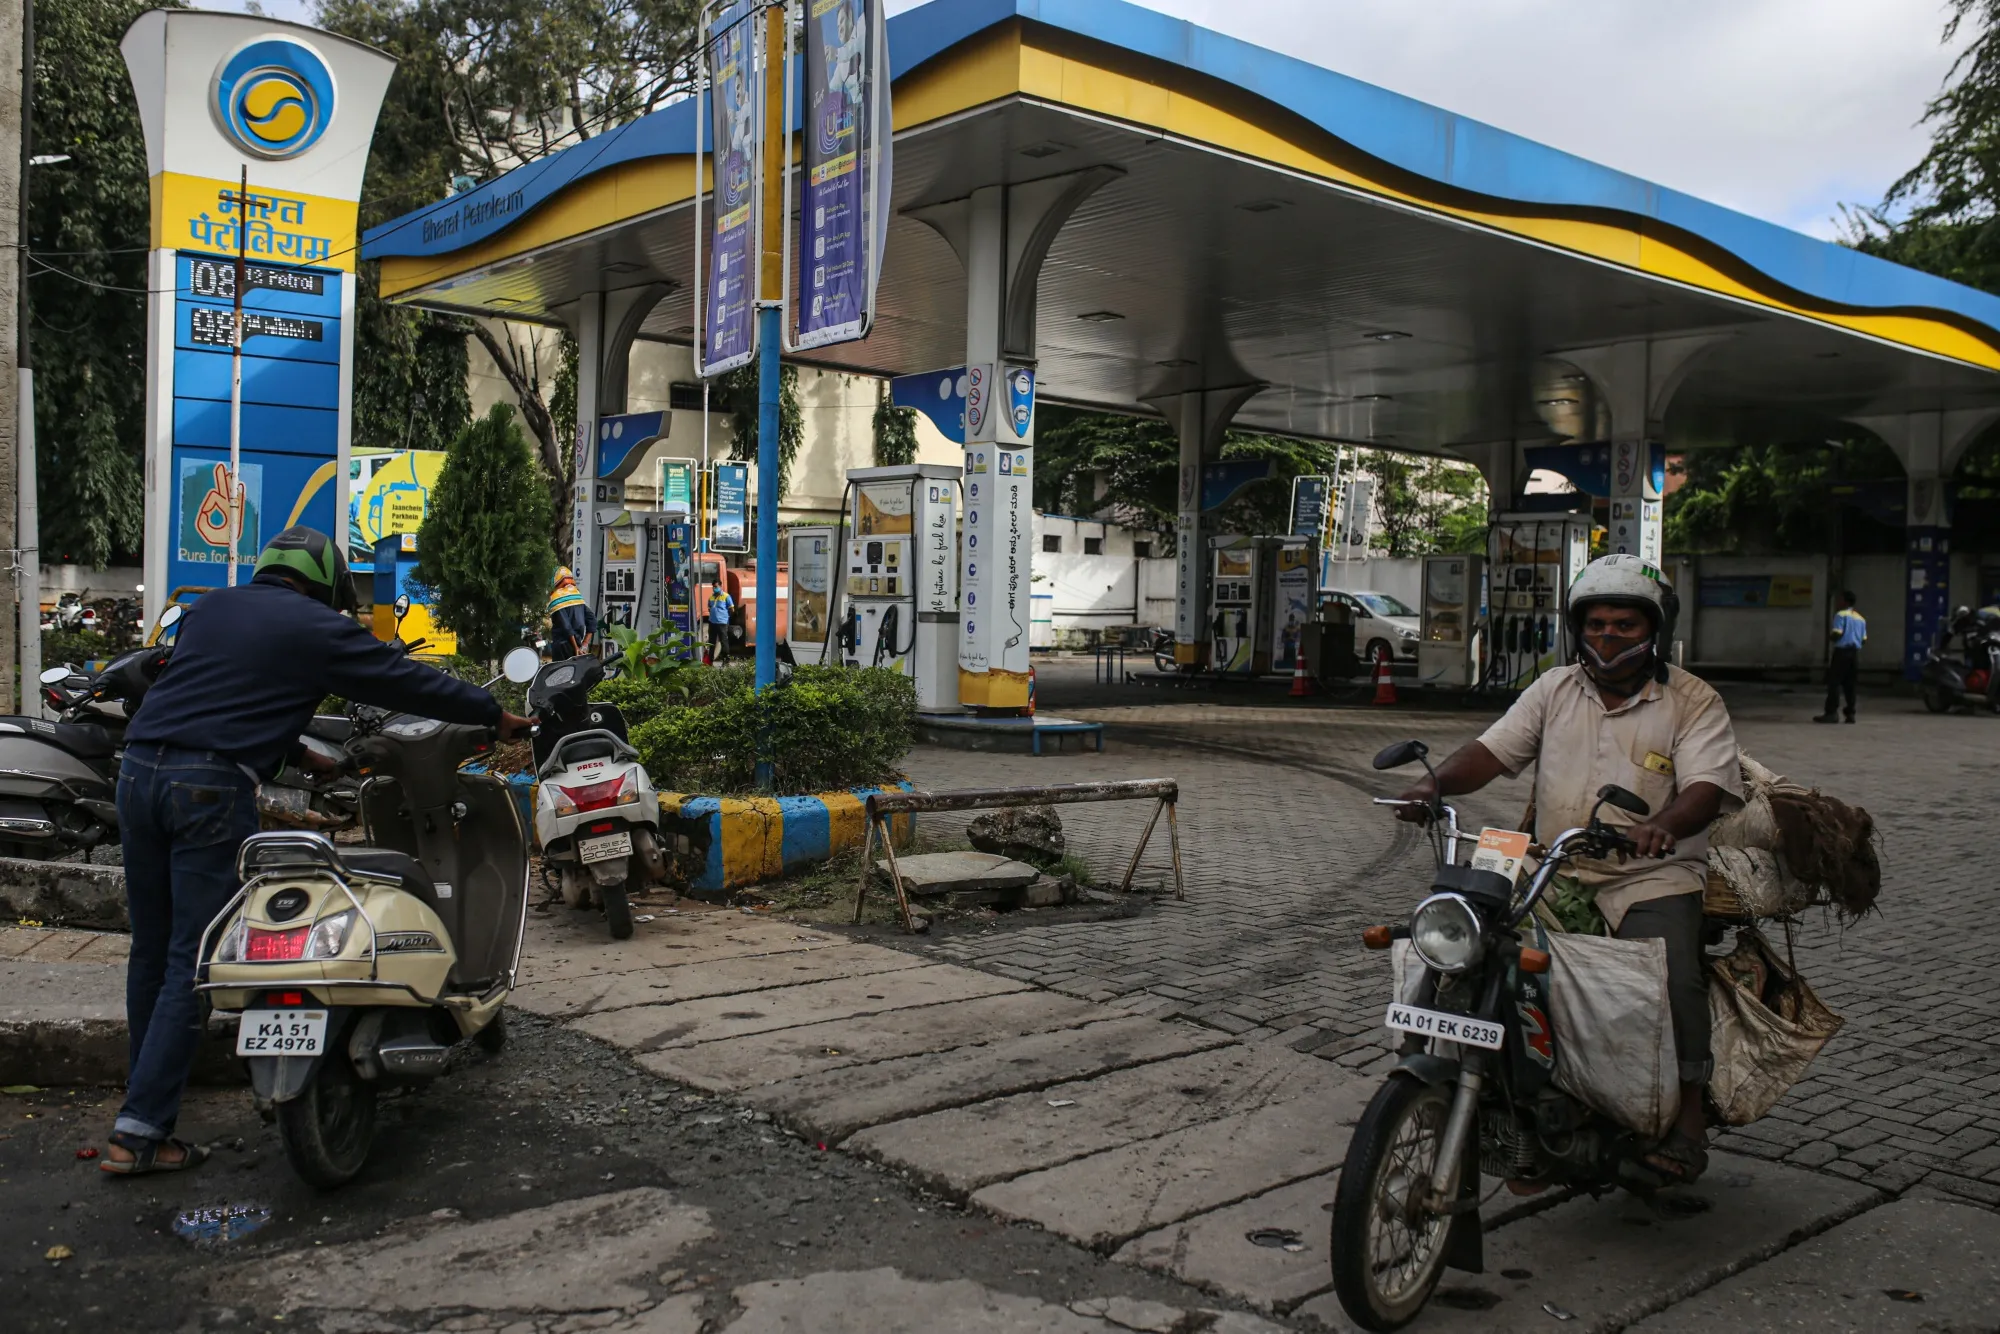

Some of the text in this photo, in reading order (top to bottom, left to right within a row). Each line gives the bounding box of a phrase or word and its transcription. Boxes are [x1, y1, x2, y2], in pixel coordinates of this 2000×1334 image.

[218, 189, 306, 225] भारत
[423, 190, 524, 244] Bharat Petroleum
[179, 548, 206, 561] Pure
[211, 550, 228, 562] for
[576, 761, 604, 772] PRESS
[582, 845, 631, 862] 2050
[259, 1024, 309, 1037] KA 51
[1391, 1010, 1498, 1043] KA 01 EK 6239
[245, 1038, 316, 1051] EZ 4978
